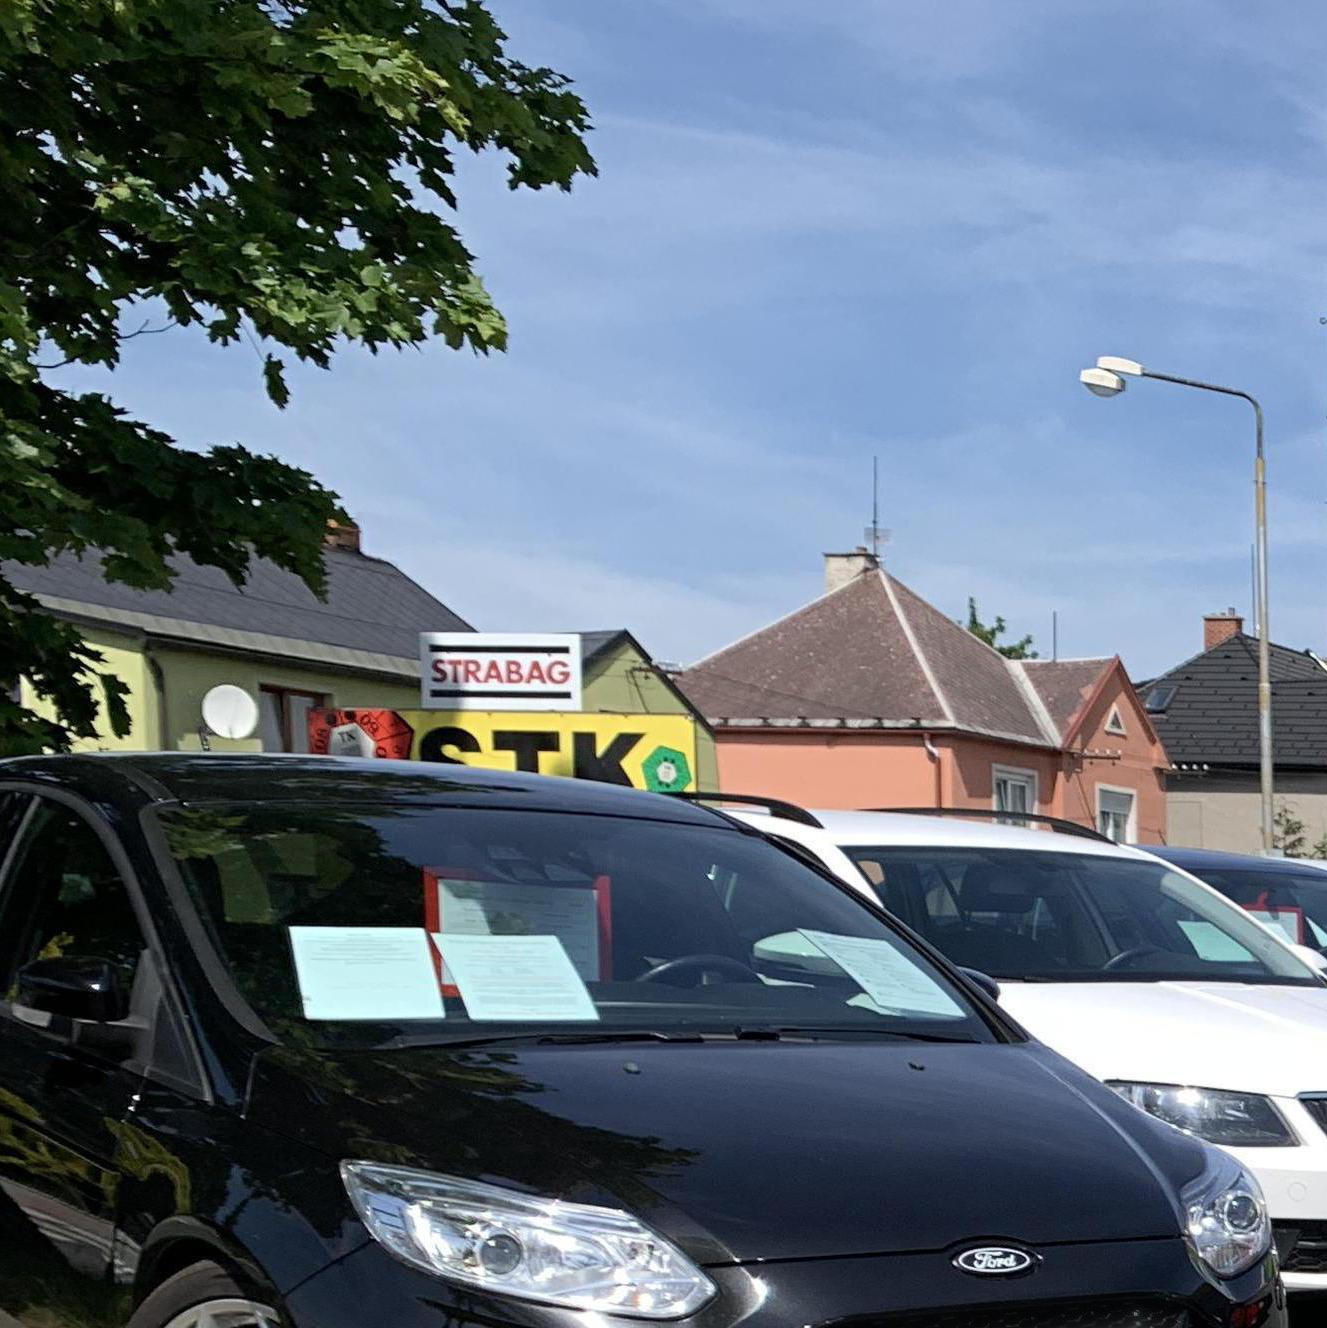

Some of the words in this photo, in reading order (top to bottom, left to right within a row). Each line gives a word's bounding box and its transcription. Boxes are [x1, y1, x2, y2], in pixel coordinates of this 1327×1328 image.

[431, 658, 571, 685] STRABAG
[420, 726, 648, 788] STK
[973, 1251, 1017, 1269] Ford
